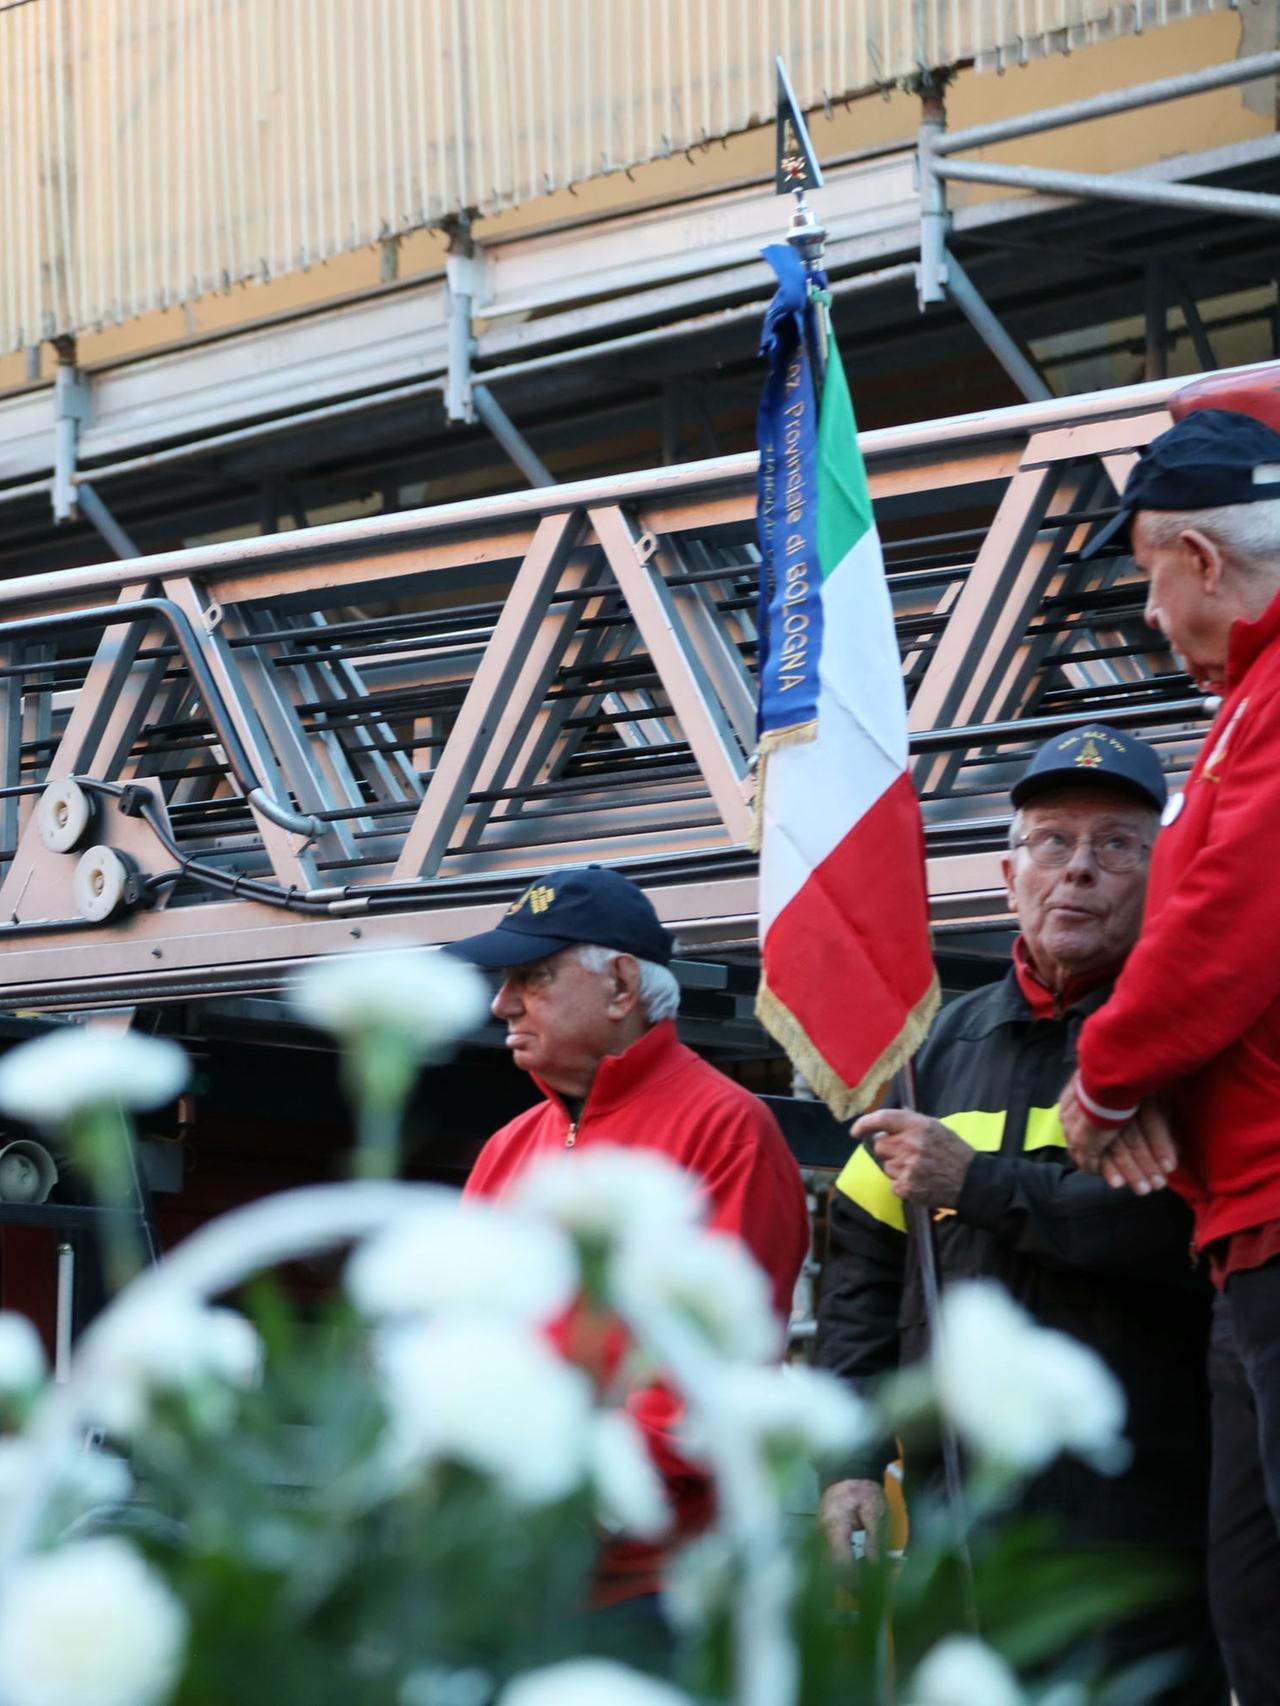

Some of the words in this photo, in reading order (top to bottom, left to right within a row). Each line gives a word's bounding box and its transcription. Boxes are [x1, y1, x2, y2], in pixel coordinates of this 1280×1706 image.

[784, 400, 807, 524] Provinciale
[785, 534, 807, 556] di
[778, 562, 810, 693] BOLOGNA
